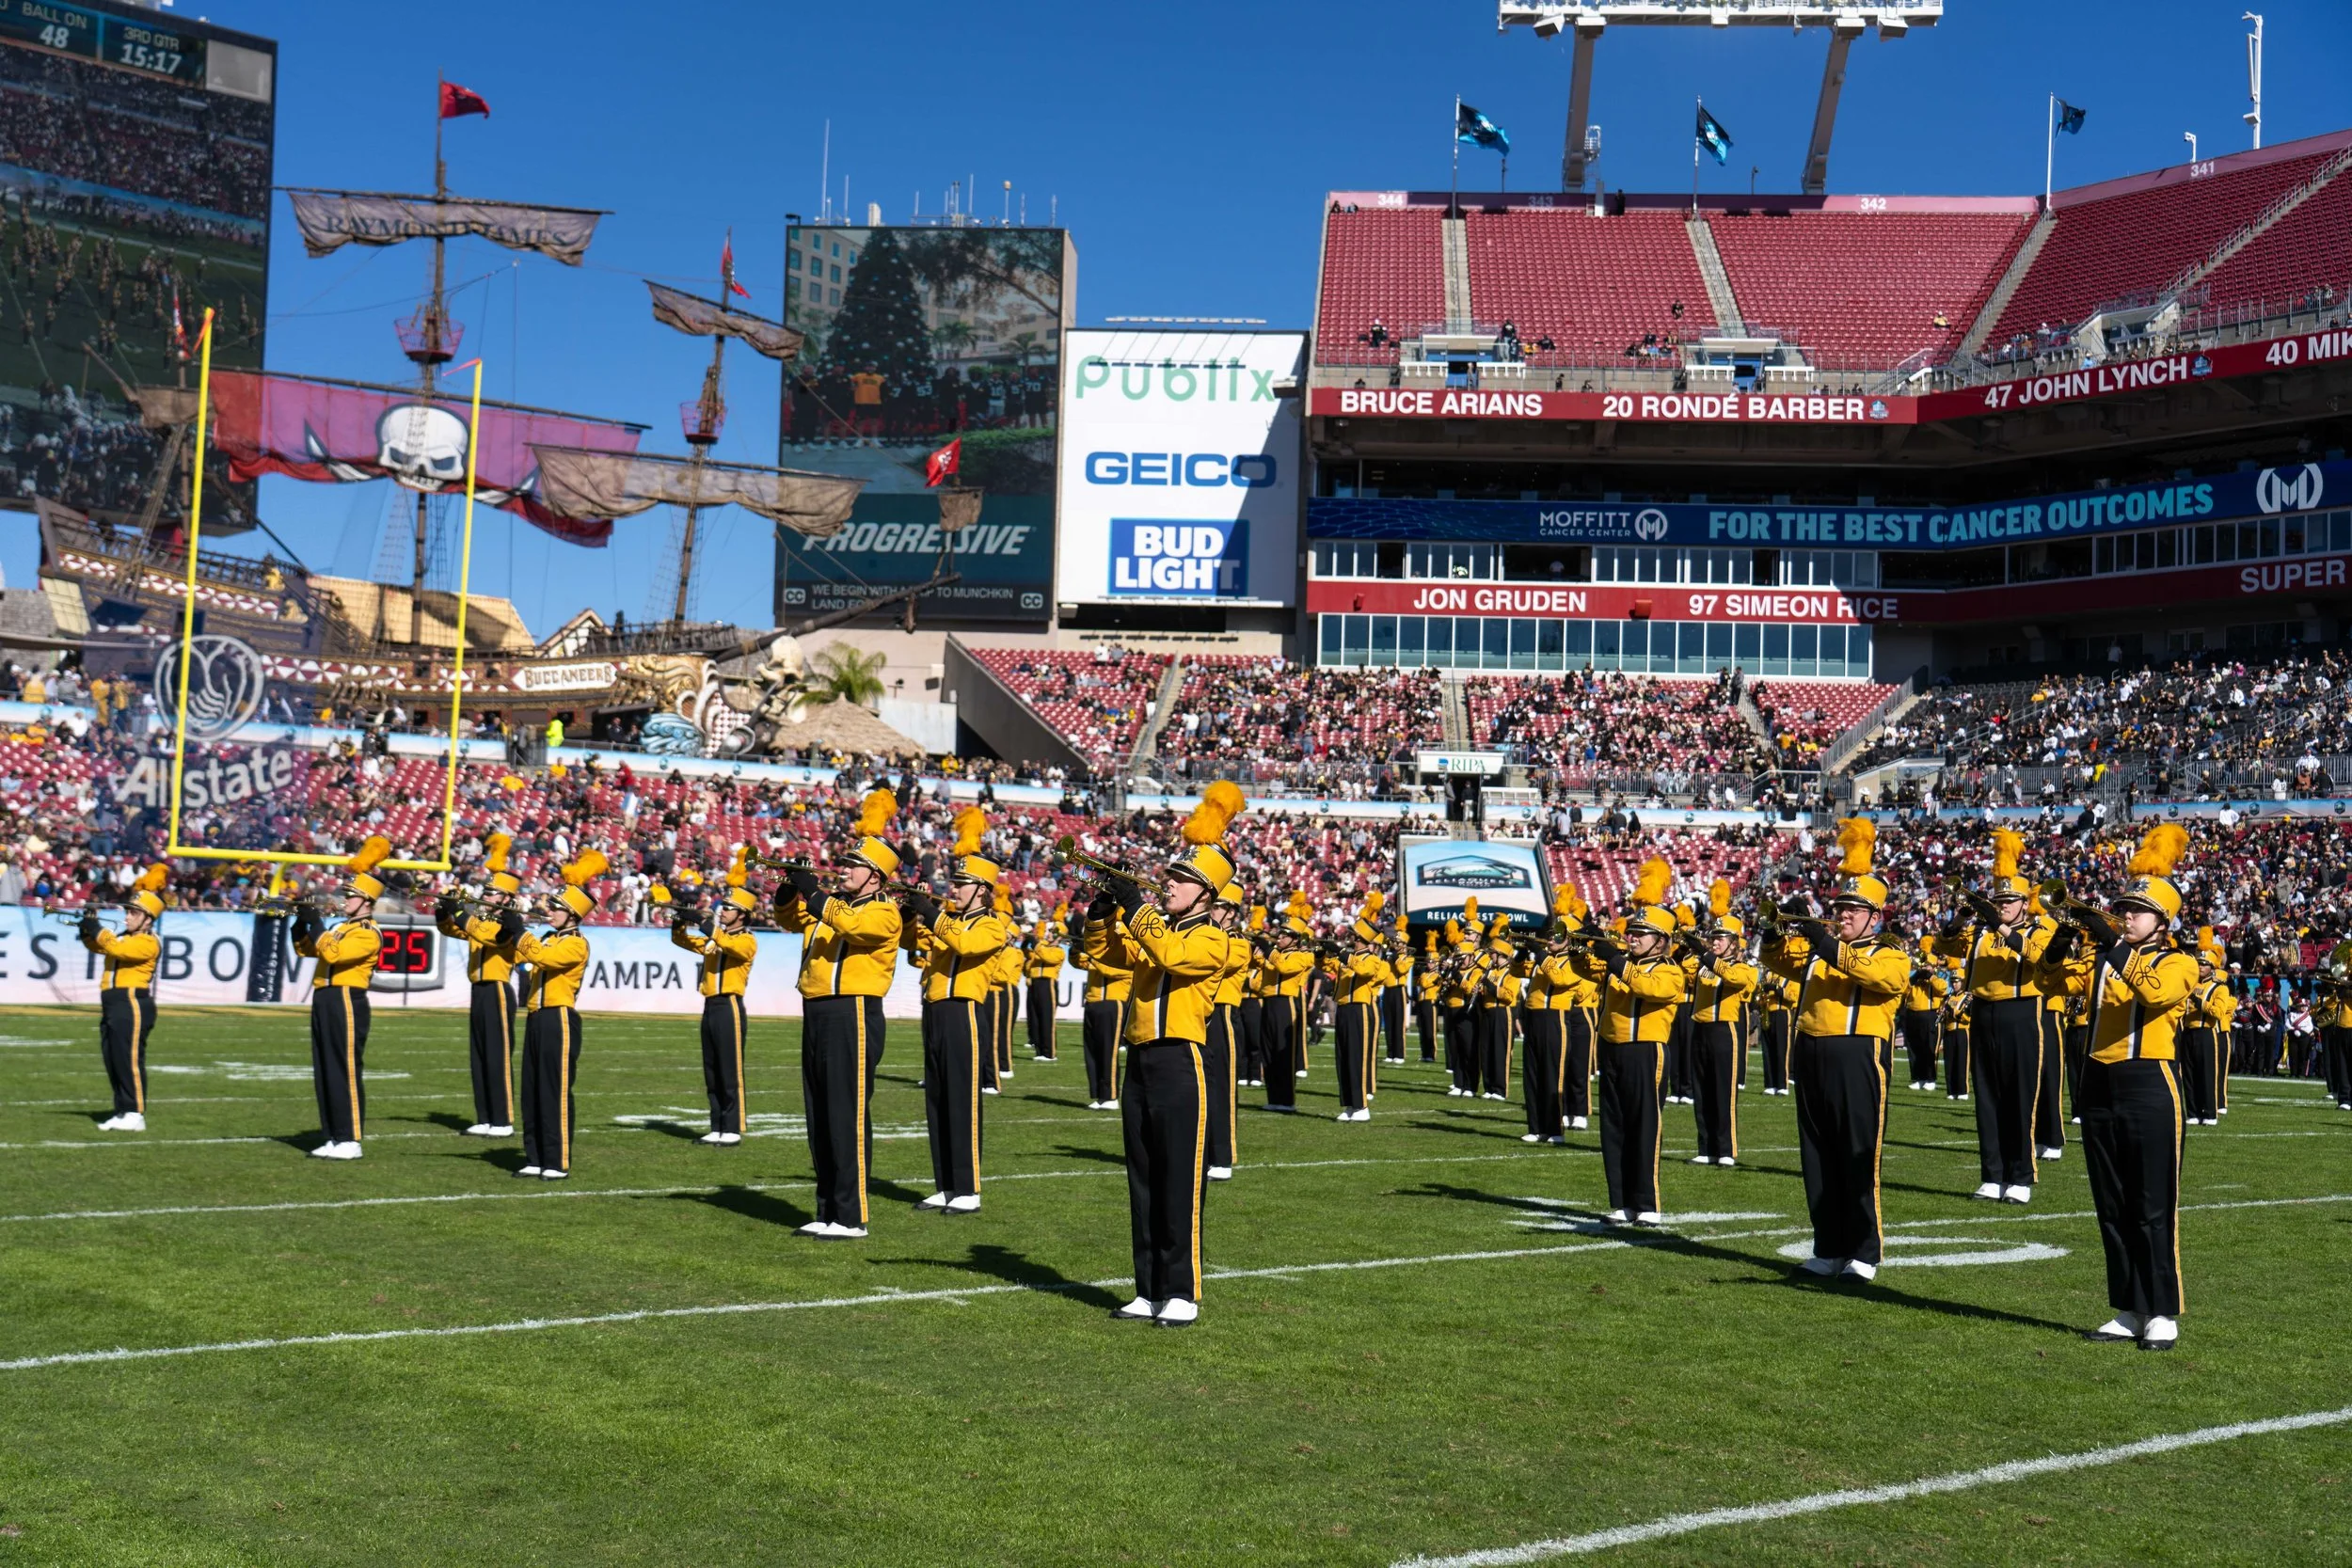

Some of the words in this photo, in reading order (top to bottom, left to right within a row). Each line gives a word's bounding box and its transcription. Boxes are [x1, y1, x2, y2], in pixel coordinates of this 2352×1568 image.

[23, 4, 59, 24] BALL
[64, 12, 87, 29] ON
[40, 24, 69, 49] 48
[123, 26, 151, 44] 3RD
[152, 31, 180, 51] QTR
[119, 42, 182, 75] 15:17
[2190, 160, 2215, 178] 341
[1377, 193, 1404, 206] 344
[1528, 196, 1553, 208] 343
[1860, 197, 1886, 210] 342
[2265, 340, 2298, 366] 40
[1984, 384, 2012, 409] 47
[2018, 372, 2090, 405] JOHN
[2098, 356, 2187, 393] LYNCH
[1341, 390, 1434, 415] BRUCE
[1440, 392, 1543, 416] ARIANS
[1602, 395, 1634, 418] 20
[1641, 392, 1740, 419] RONDÉ
[1747, 396, 1865, 420] BARBER
[1085, 451, 1277, 487] GEICO
[1539, 511, 1631, 529] MOFFITT
[1708, 511, 1771, 540] FOR
[1776, 512, 1837, 542] THE
[1843, 514, 1923, 543] BEST
[1929, 504, 2042, 544] CANCER
[2047, 483, 2214, 531] OUTCOMES
[802, 522, 1032, 555] PROGRESIVE
[1133, 525, 1224, 558] BUD
[1539, 528, 1583, 536] CANCER
[1588, 529, 1631, 537] CENTER
[1115, 557, 1241, 590] LIGHT
[2239, 558, 2346, 594] SUPER
[812, 584, 831, 595] WE
[832, 584, 867, 596] BEGIN
[937, 586, 952, 598] TO
[953, 586, 1014, 599] MUNCHKIN
[812, 598, 845, 610] LAND
[1413, 588, 1467, 610] JON
[1474, 589, 1586, 611] GRUDEN
[1689, 594, 1718, 616] 97
[1725, 594, 1829, 618] SIMEON
[1836, 596, 1899, 620] RICE
[524, 665, 612, 689] BUCCANEERS
[1426, 911, 1494, 923] RELIAQEST
[377, 930, 428, 972] 25
[587, 959, 683, 990] AMPA
